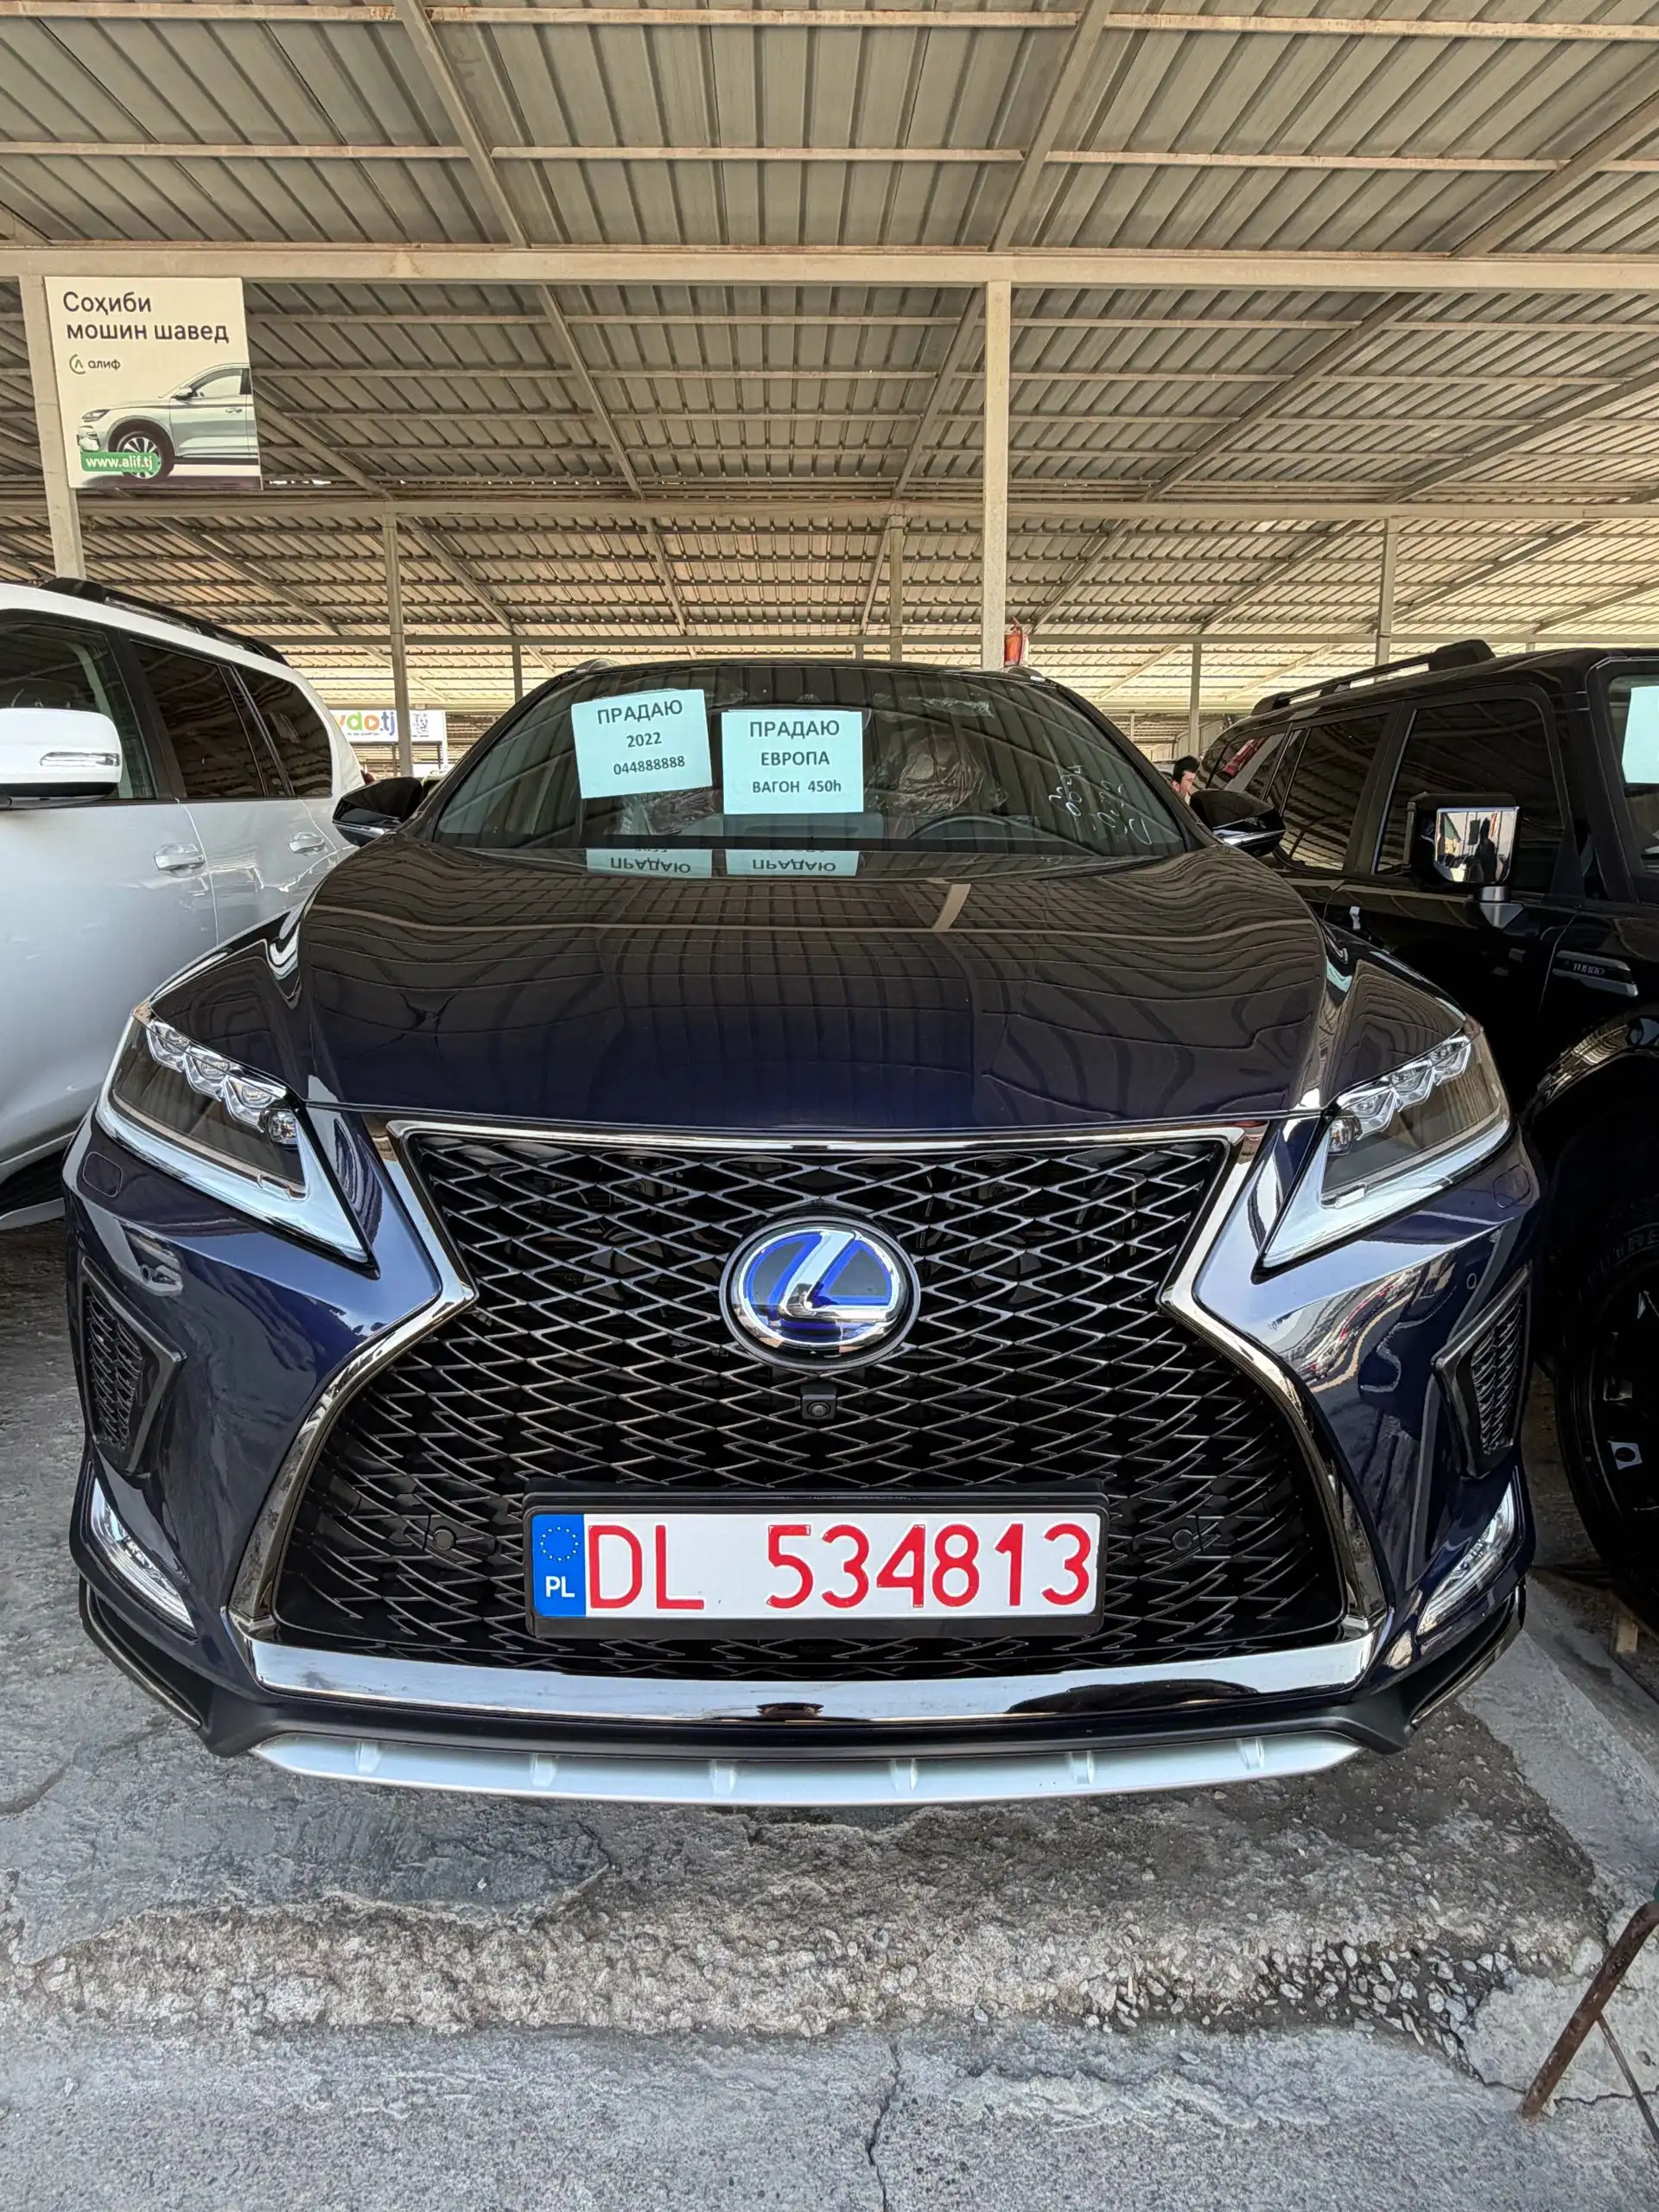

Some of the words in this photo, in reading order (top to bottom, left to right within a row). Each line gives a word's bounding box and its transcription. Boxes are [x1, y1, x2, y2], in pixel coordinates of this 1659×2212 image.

[63, 291, 151, 315] Соҳиби
[67, 324, 147, 340] мошин
[154, 324, 229, 344] шавед
[87, 358, 121, 371] алиф
[86, 456, 153, 471] www.alif.tj
[597, 700, 683, 724] ПРАДАЮ
[626, 732, 662, 747] 2022
[750, 720, 840, 740] ПРАДАЮ
[613, 756, 685, 775] 044888888
[761, 751, 830, 766] ЕВРОПА
[753, 780, 800, 793] ВАГОН
[808, 779, 842, 792] 450h
[588, 1524, 705, 1610] DL
[766, 1522, 1092, 1610] 534813
[545, 1575, 575, 1599] PL
